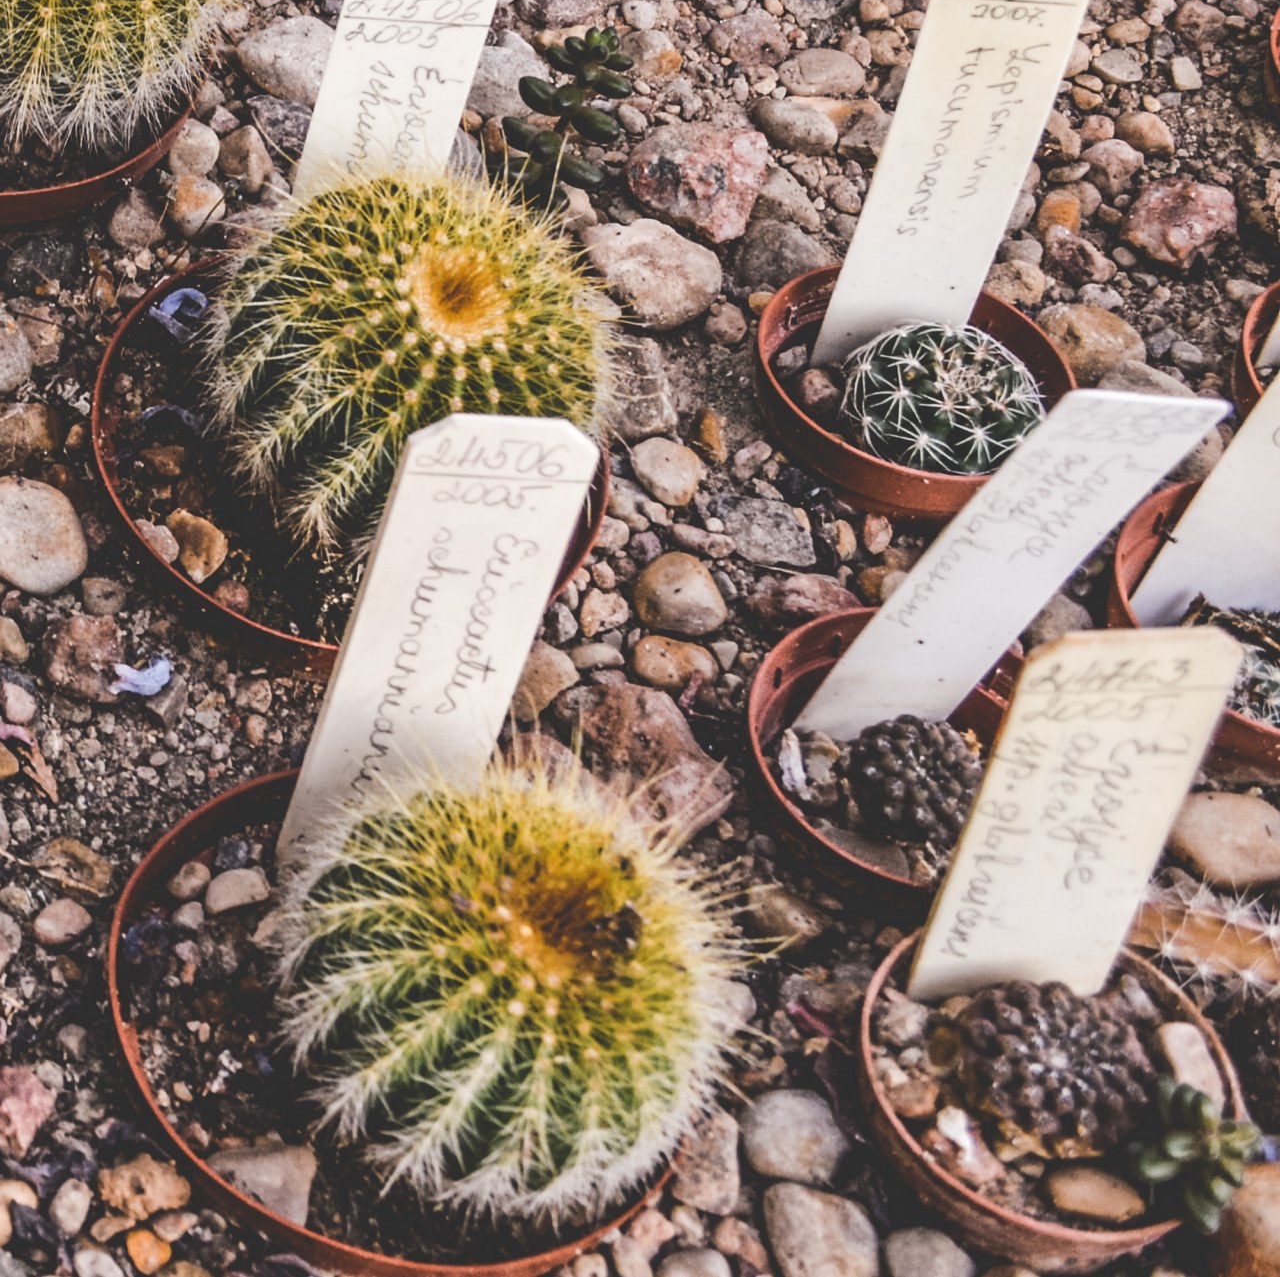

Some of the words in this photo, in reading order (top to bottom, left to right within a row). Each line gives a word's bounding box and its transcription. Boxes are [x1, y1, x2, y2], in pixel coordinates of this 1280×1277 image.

[344, 23, 452, 49] 2005
[894, 44, 997, 237] tucumanensis
[411, 436, 567, 481] 24506
